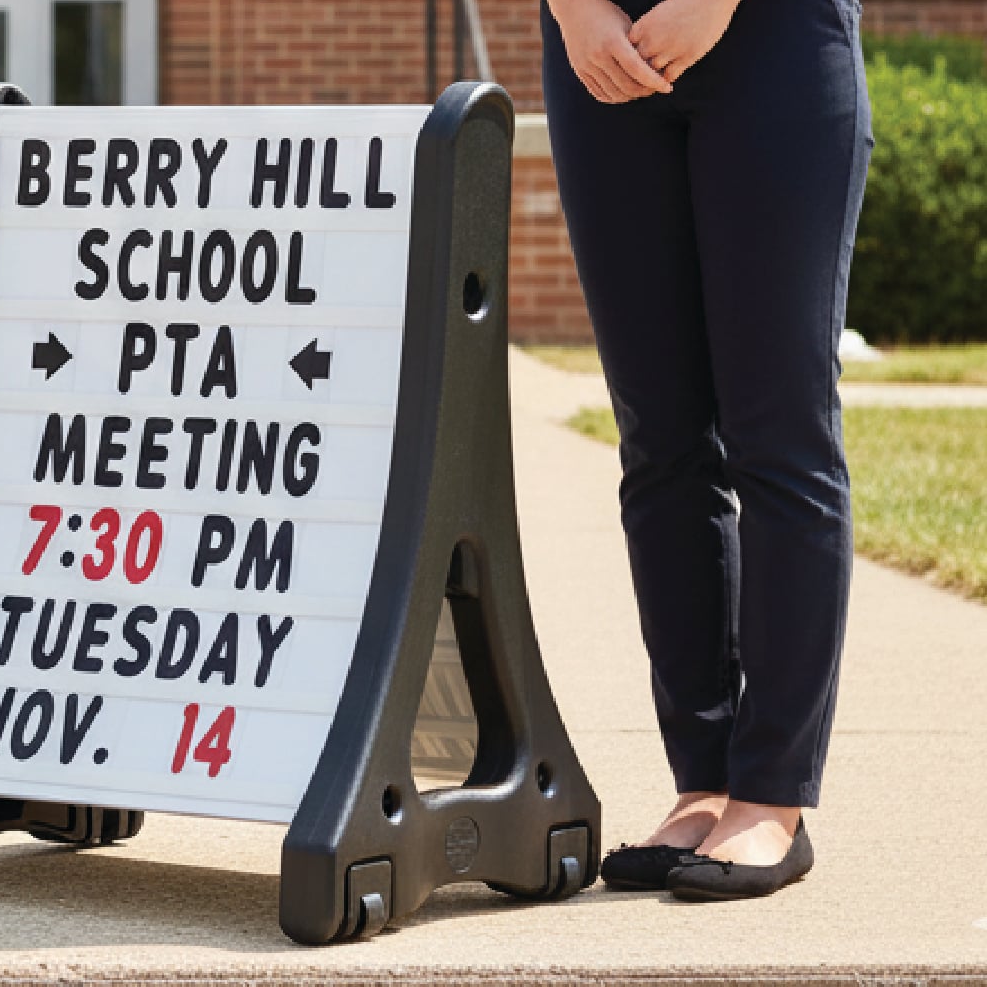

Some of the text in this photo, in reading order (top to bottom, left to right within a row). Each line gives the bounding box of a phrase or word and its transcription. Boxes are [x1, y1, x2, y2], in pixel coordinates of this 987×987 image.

[17, 136, 397, 209] BERRY HILL
[73, 227, 316, 306] SCHOOL
[118, 322, 237, 400] PTA
[32, 412, 322, 498] MEETING
[21, 504, 295, 594] 7:30 PM
[170, 702, 236, 778] 14
